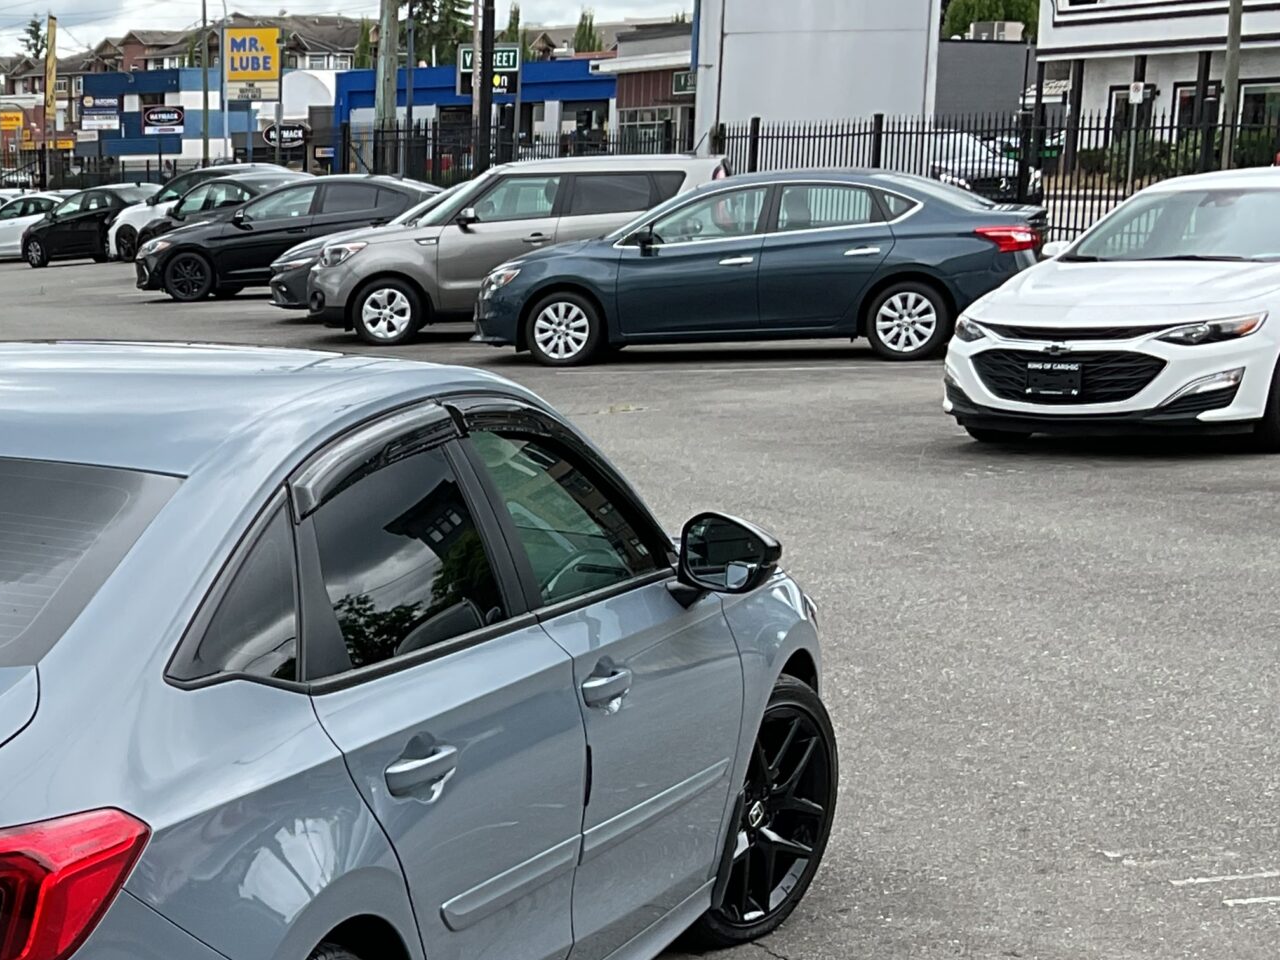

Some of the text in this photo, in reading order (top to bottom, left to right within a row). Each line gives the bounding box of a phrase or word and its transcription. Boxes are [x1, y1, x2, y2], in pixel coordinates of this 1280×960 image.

[230, 36, 265, 52] MR.
[230, 55, 272, 72] LUBE
[465, 52, 472, 67] V
[269, 129, 303, 139] HMACK
